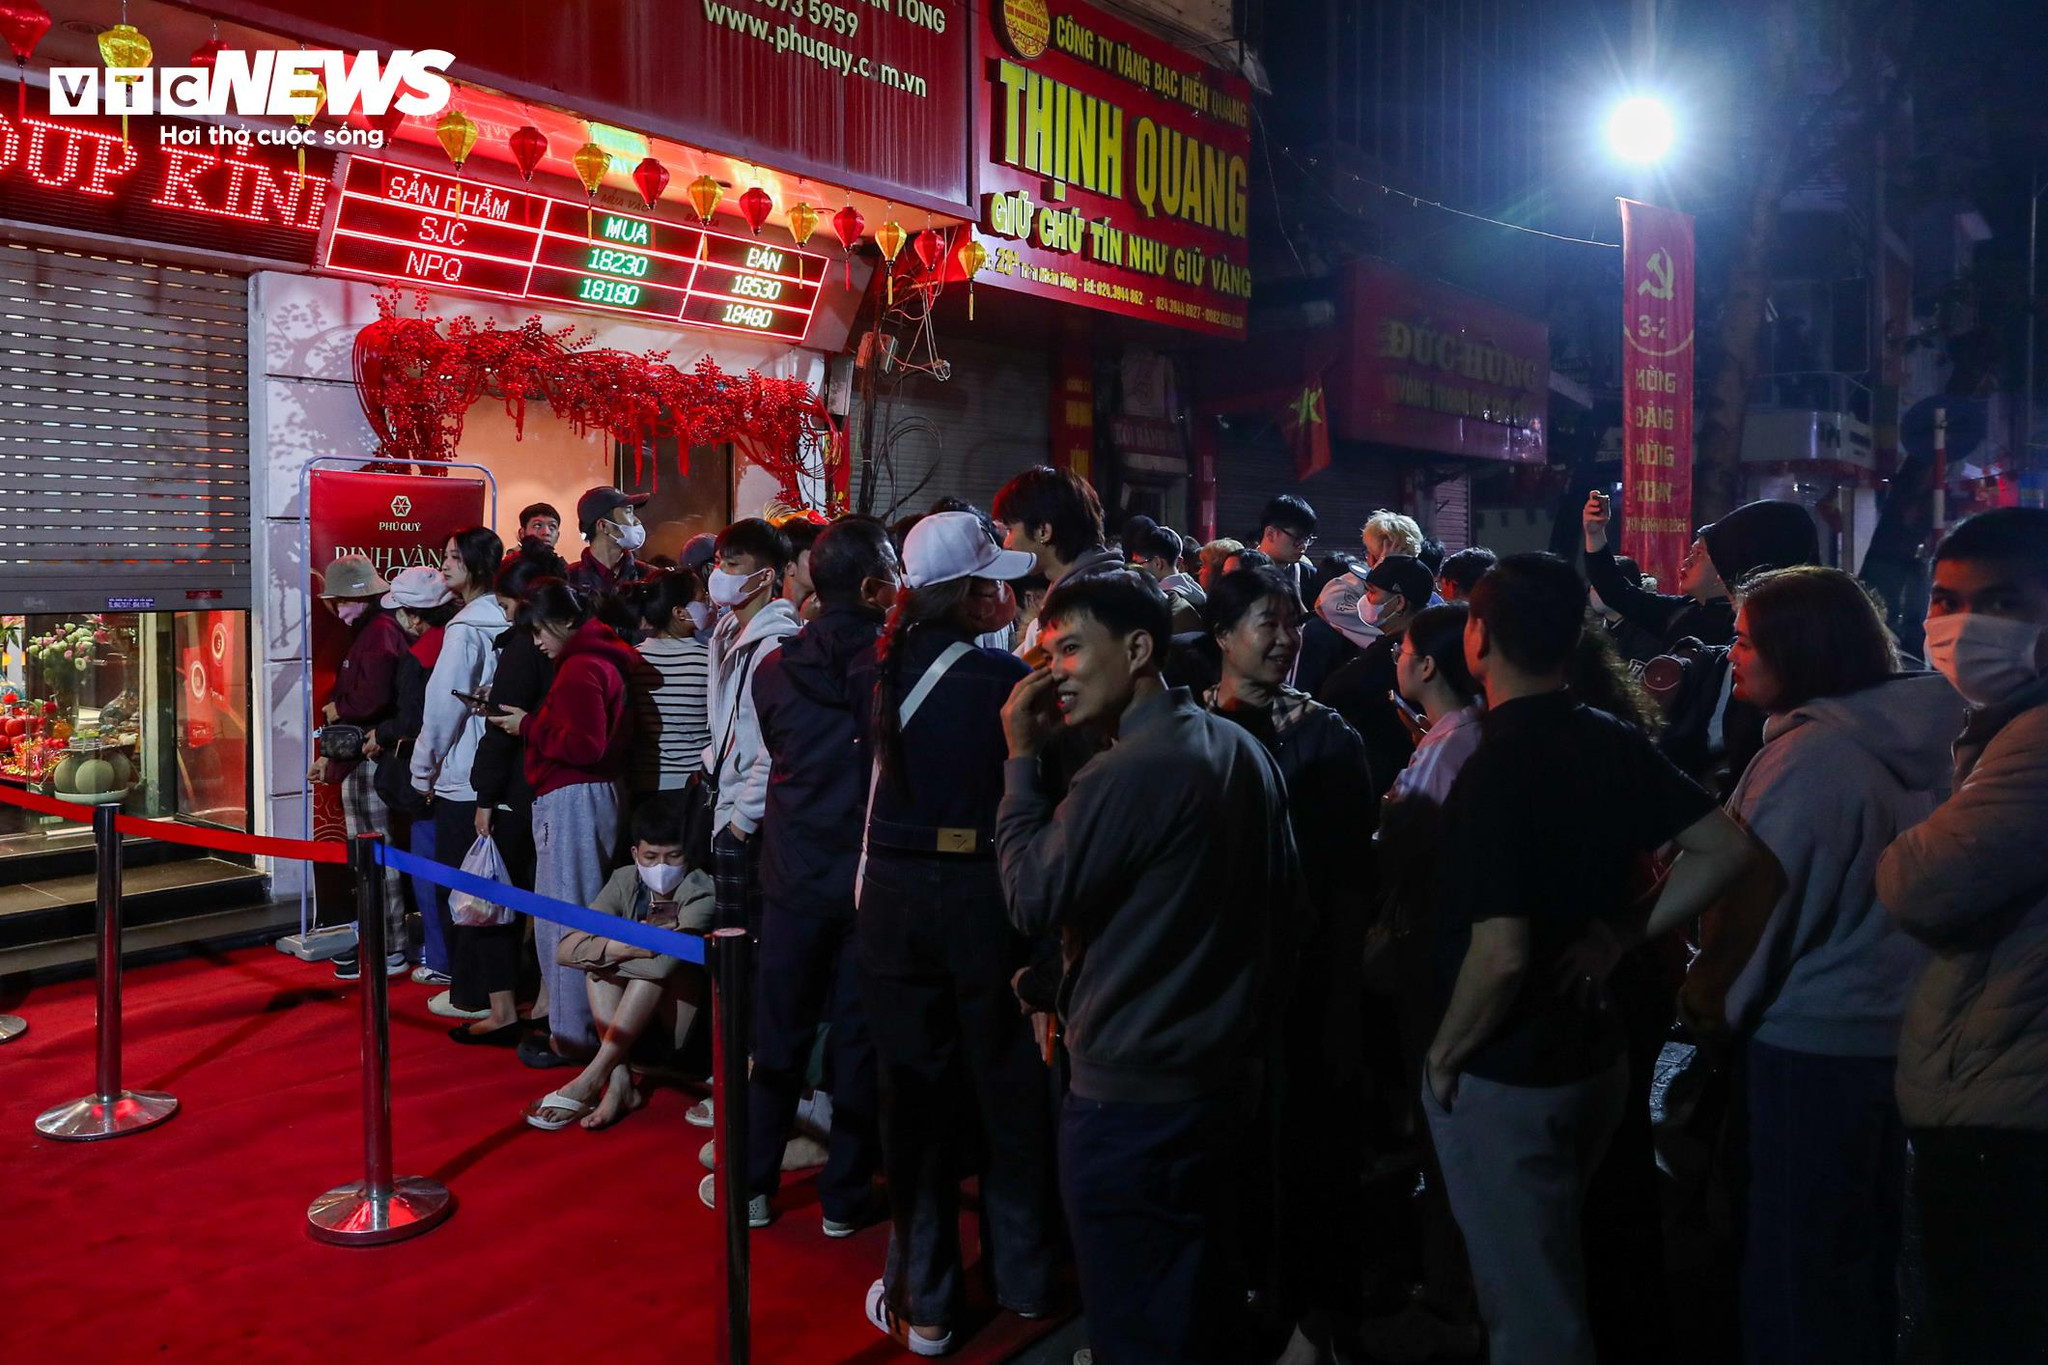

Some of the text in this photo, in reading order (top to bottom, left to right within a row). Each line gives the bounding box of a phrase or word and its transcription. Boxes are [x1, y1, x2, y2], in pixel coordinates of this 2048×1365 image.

[809, 0, 859, 37] 5959
[704, 0, 927, 97] www.phuquy.cm.vn
[1056, 15, 1094, 59] CÔNG
[1097, 37, 1113, 69] TY
[1117, 42, 1151, 84] VÀNG
[1154, 63, 1178, 99] BẠC
[1211, 88, 1248, 127] QUANG
[1000, 59, 1248, 238] THỊNH QUANG
[388, 173, 438, 212] SẢN
[418, 216, 468, 246] SJC
[603, 216, 648, 245] MUA
[990, 188, 1252, 299] GIỮ CHỮ TÍN NHƯ GIỮ VÀNG
[405, 250, 463, 282] NPQ
[587, 246, 648, 278] 18230
[746, 245, 782, 273] BÁN
[579, 278, 639, 307] 18180
[730, 274, 781, 301] 18530
[721, 302, 772, 329] 18480
